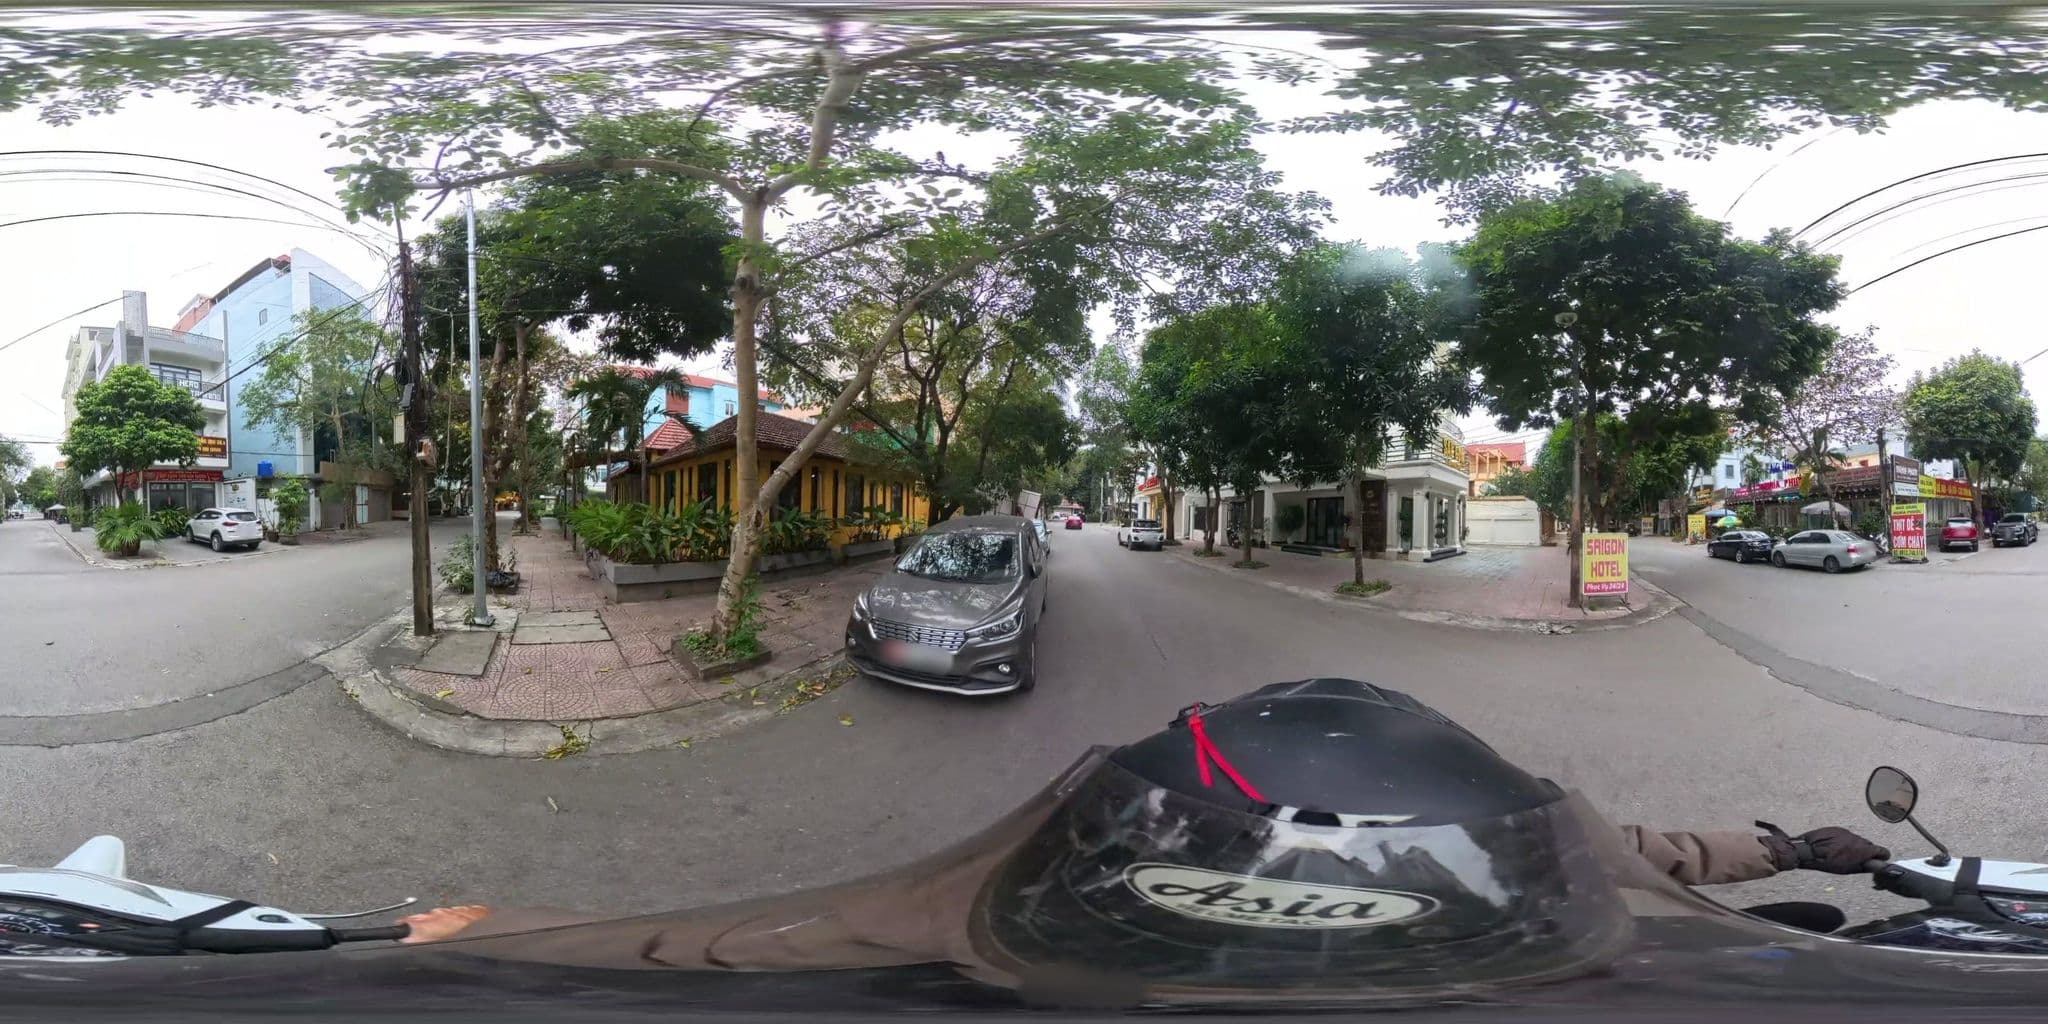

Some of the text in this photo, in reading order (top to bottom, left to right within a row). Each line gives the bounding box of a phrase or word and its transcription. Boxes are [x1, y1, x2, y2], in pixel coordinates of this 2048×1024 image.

[1586, 538, 1625, 556] SAIGON
[1591, 560, 1622, 578] HOTEL
[1149, 881, 1385, 919] Asia
